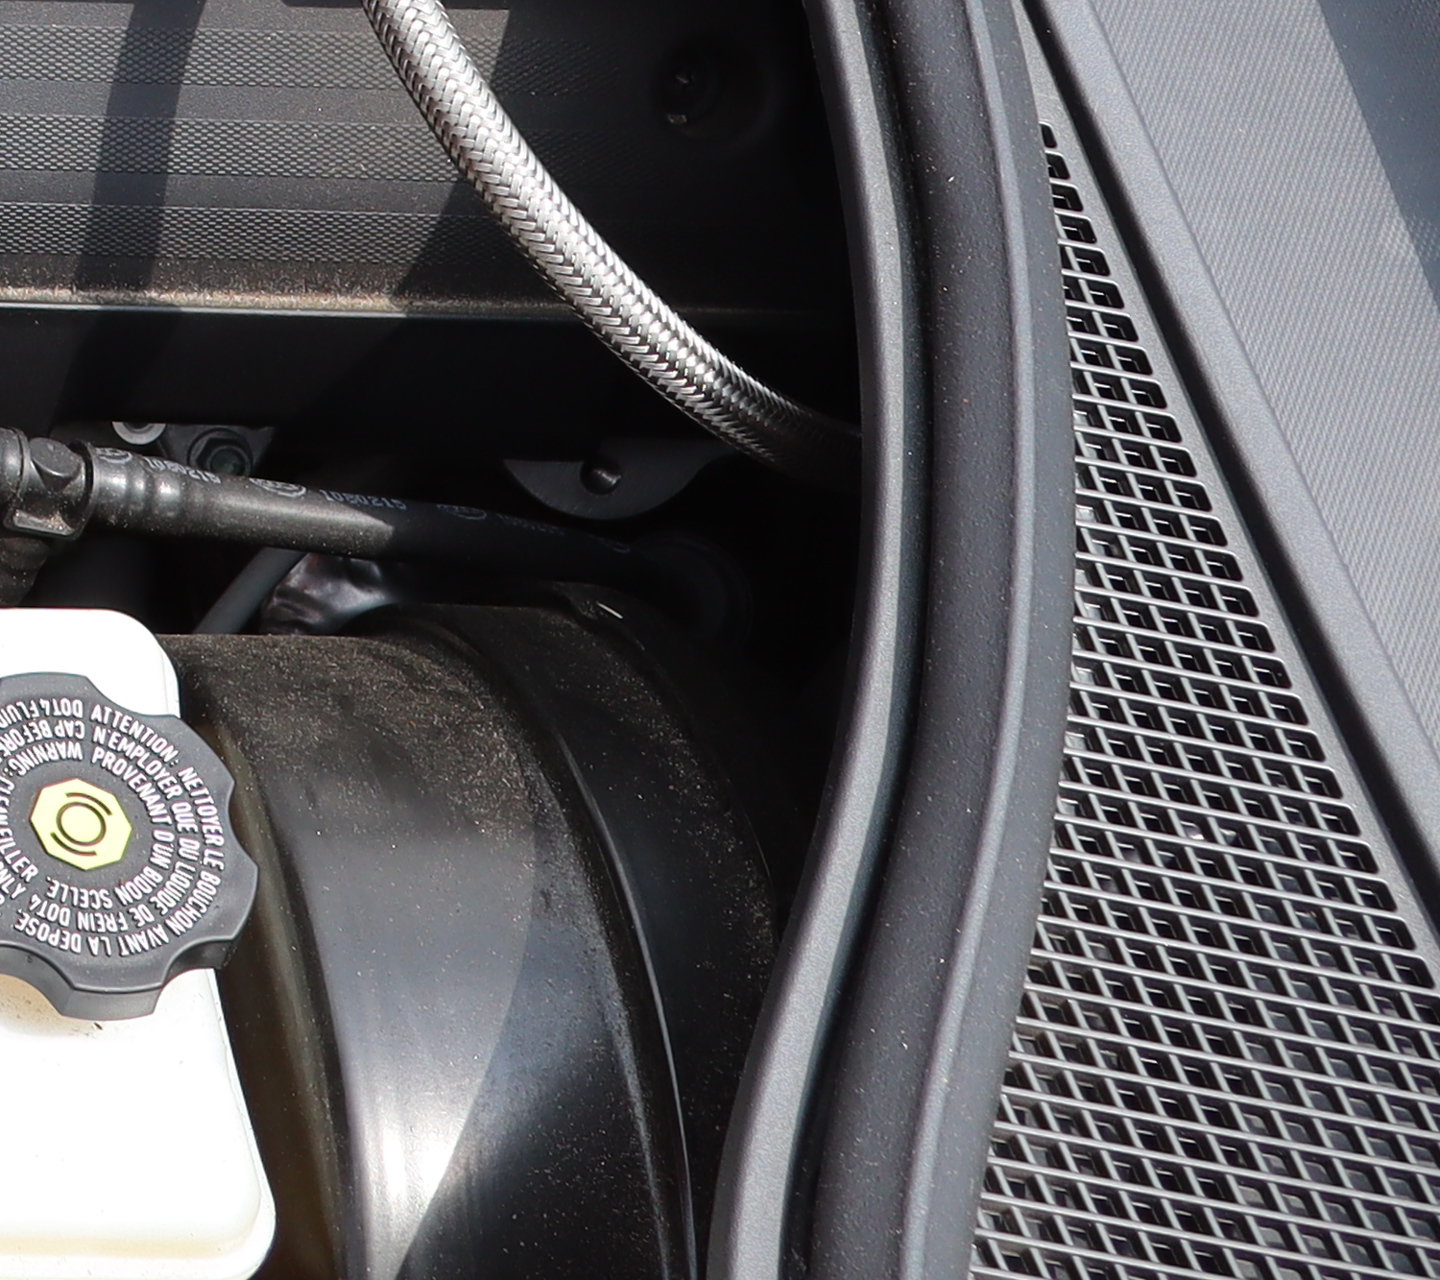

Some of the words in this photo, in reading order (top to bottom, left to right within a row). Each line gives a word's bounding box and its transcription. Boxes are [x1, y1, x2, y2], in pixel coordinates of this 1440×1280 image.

[39, 698, 83, 719] DOT4
[53, 719, 85, 739] CAP
[90, 704, 179, 766] ATTENTION:
[3, 741, 83, 777] WARNING:
[91, 745, 173, 826] PROVENANT
[171, 802, 199, 833] QUE
[177, 766, 225, 847] NETTOYER
[149, 829, 175, 869] D'UN
[178, 837, 200, 861] DU
[203, 848, 225, 870] LE
[46, 876, 113, 910] SCELLE.
[114, 865, 164, 906] BIDON
[149, 861, 196, 915] LIQUIDE
[29, 894, 71, 927] DOT4
[128, 904, 155, 927] DE
[164, 870, 221, 936] BOUCHON
[14, 909, 82, 953] DEPOSE.
[77, 911, 129, 933] FREIN
[86, 936, 112, 956] LA
[117, 923, 169, 956] AVANT
